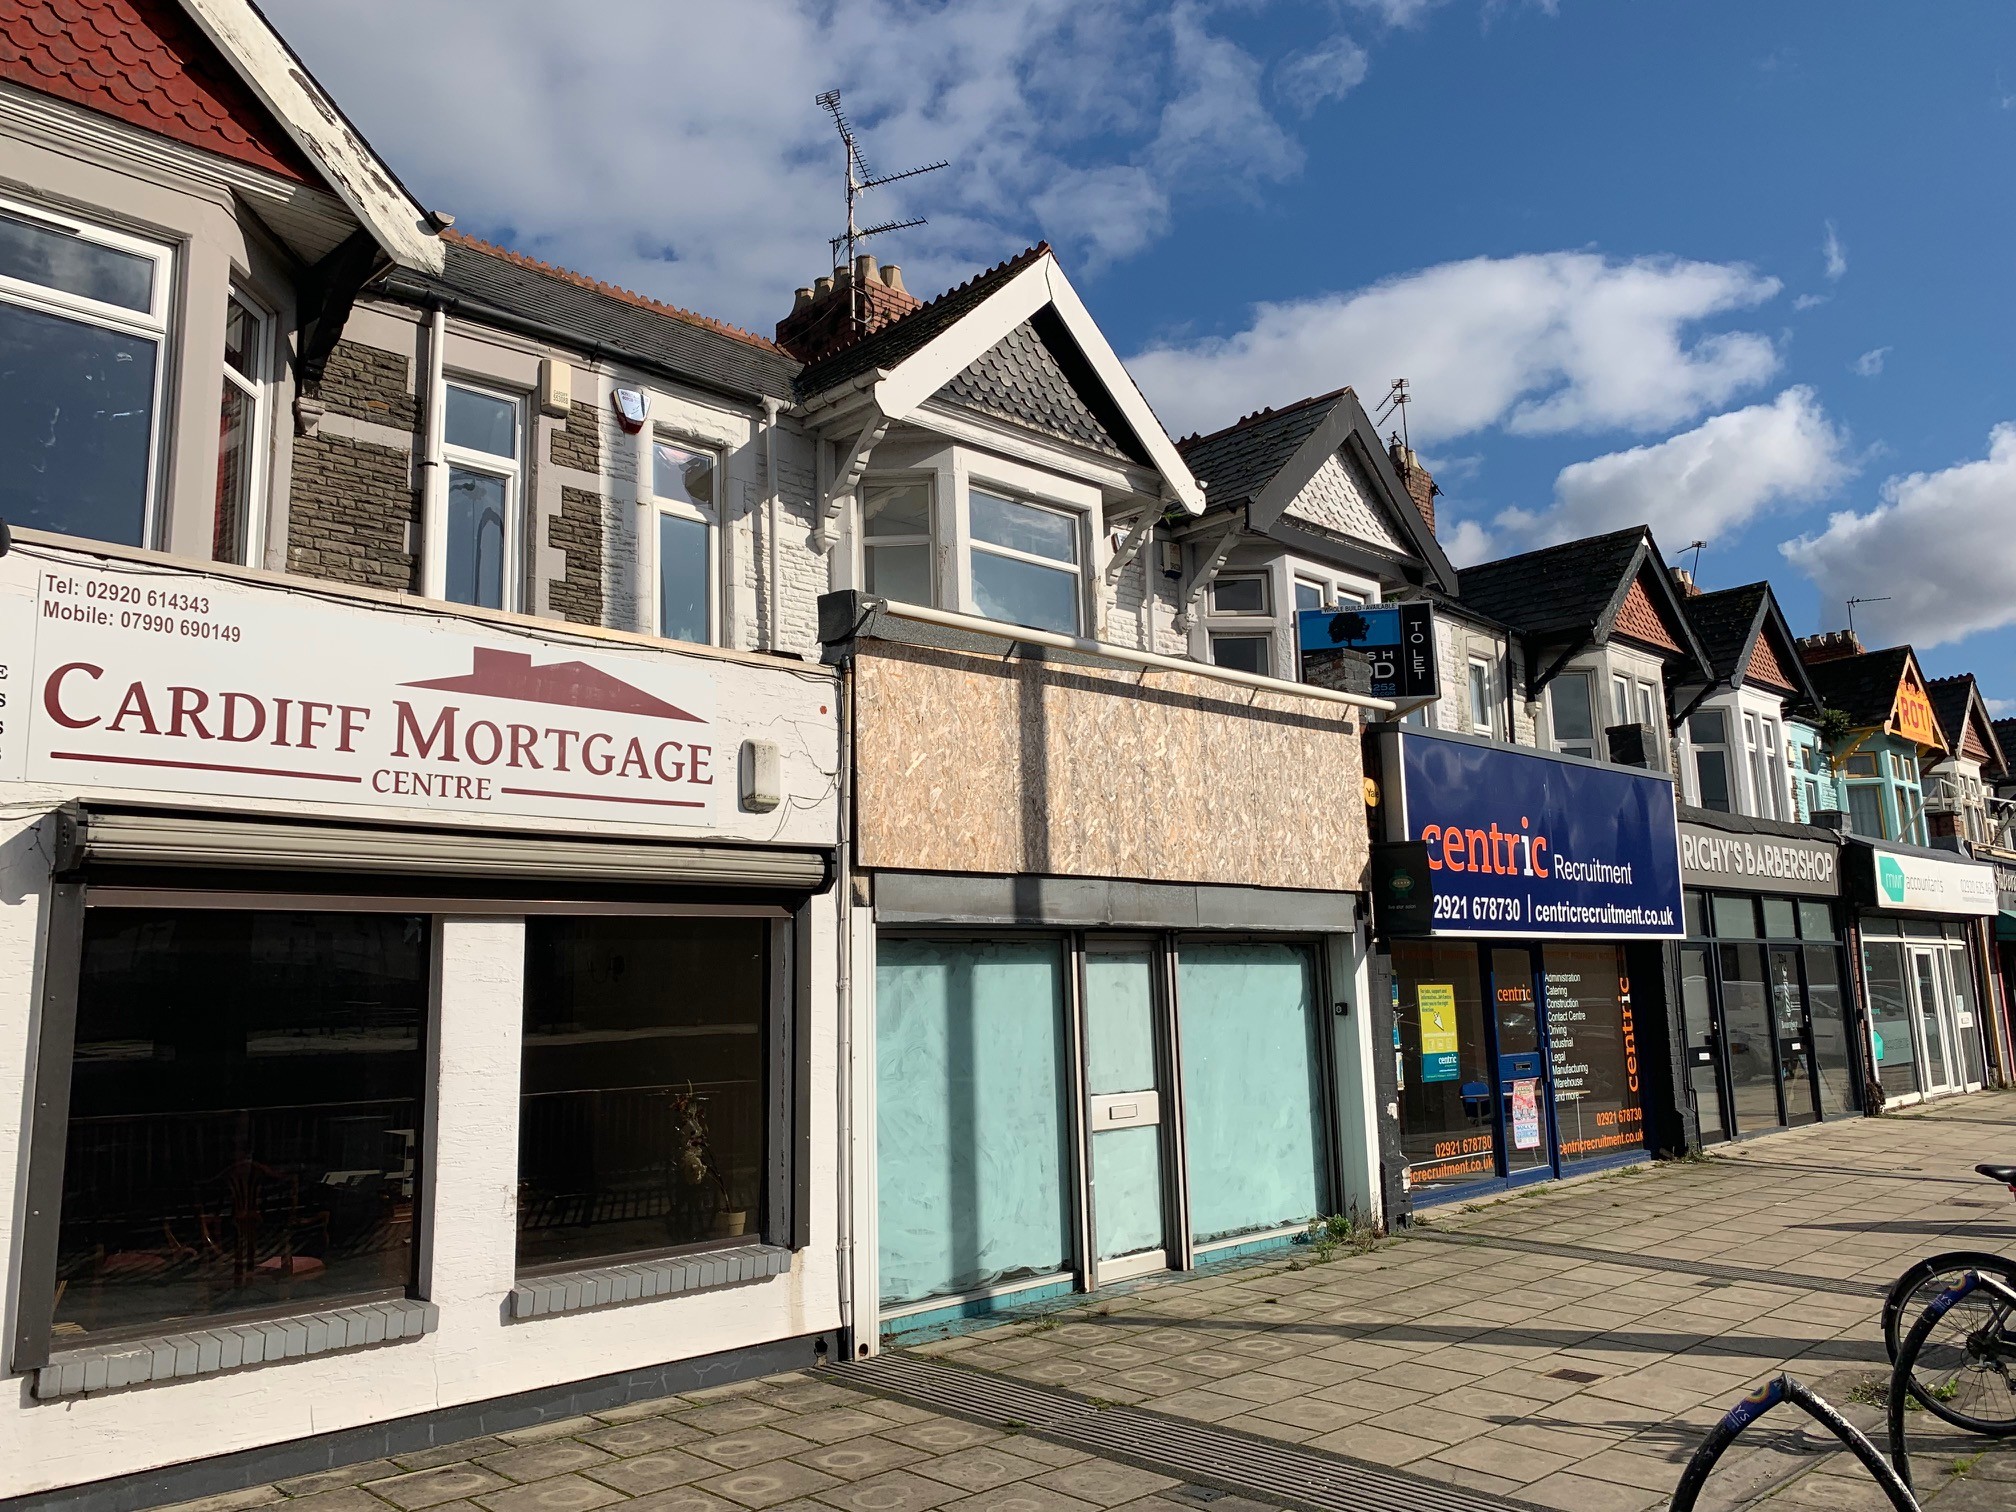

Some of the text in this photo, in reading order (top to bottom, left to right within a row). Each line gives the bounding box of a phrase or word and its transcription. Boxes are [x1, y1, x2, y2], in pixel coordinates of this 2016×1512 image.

[46, 575, 209, 614] Tel: 02920 614343
[43, 600, 241, 643] Mobile: 07990 690149
[1410, 621, 1424, 643] TO
[1413, 649, 1425, 680] LET
[1900, 696, 1931, 732] ROTI
[43, 662, 714, 785] CARDIFF MORTGAGE
[372, 769, 492, 801] CENTRE
[1366, 788, 1379, 798] Yale
[1421, 816, 1633, 885] centric Recruitment
[1681, 834, 1834, 882] RICHY'S BARBERSHOP
[1906, 876, 1944, 893] accountants
[1473, 896, 1520, 921] 678730
[1535, 901, 1674, 926] centricrecruitment.co.uk
[1545, 973, 1581, 982] Administration
[1497, 984, 1531, 1001] centric
[1545, 985, 1568, 998] Catering
[1546, 998, 1579, 1009] Construction
[1547, 1011, 1586, 1022] Contact Centre
[1548, 1024, 1568, 1037] Driving
[1618, 977, 1639, 1092] centric
[1550, 1037, 1574, 1048] Industrial
[1438, 1053, 1457, 1064] centric
[1551, 1051, 1566, 1064] Legal
[1552, 1063, 1589, 1075] Manufacturing
[1553, 1077, 1583, 1089] Warehouse
[1555, 1091, 1565, 1102] and
[1596, 1107, 1642, 1126] 02921 678730
[1435, 1140, 1460, 1158] 02921
